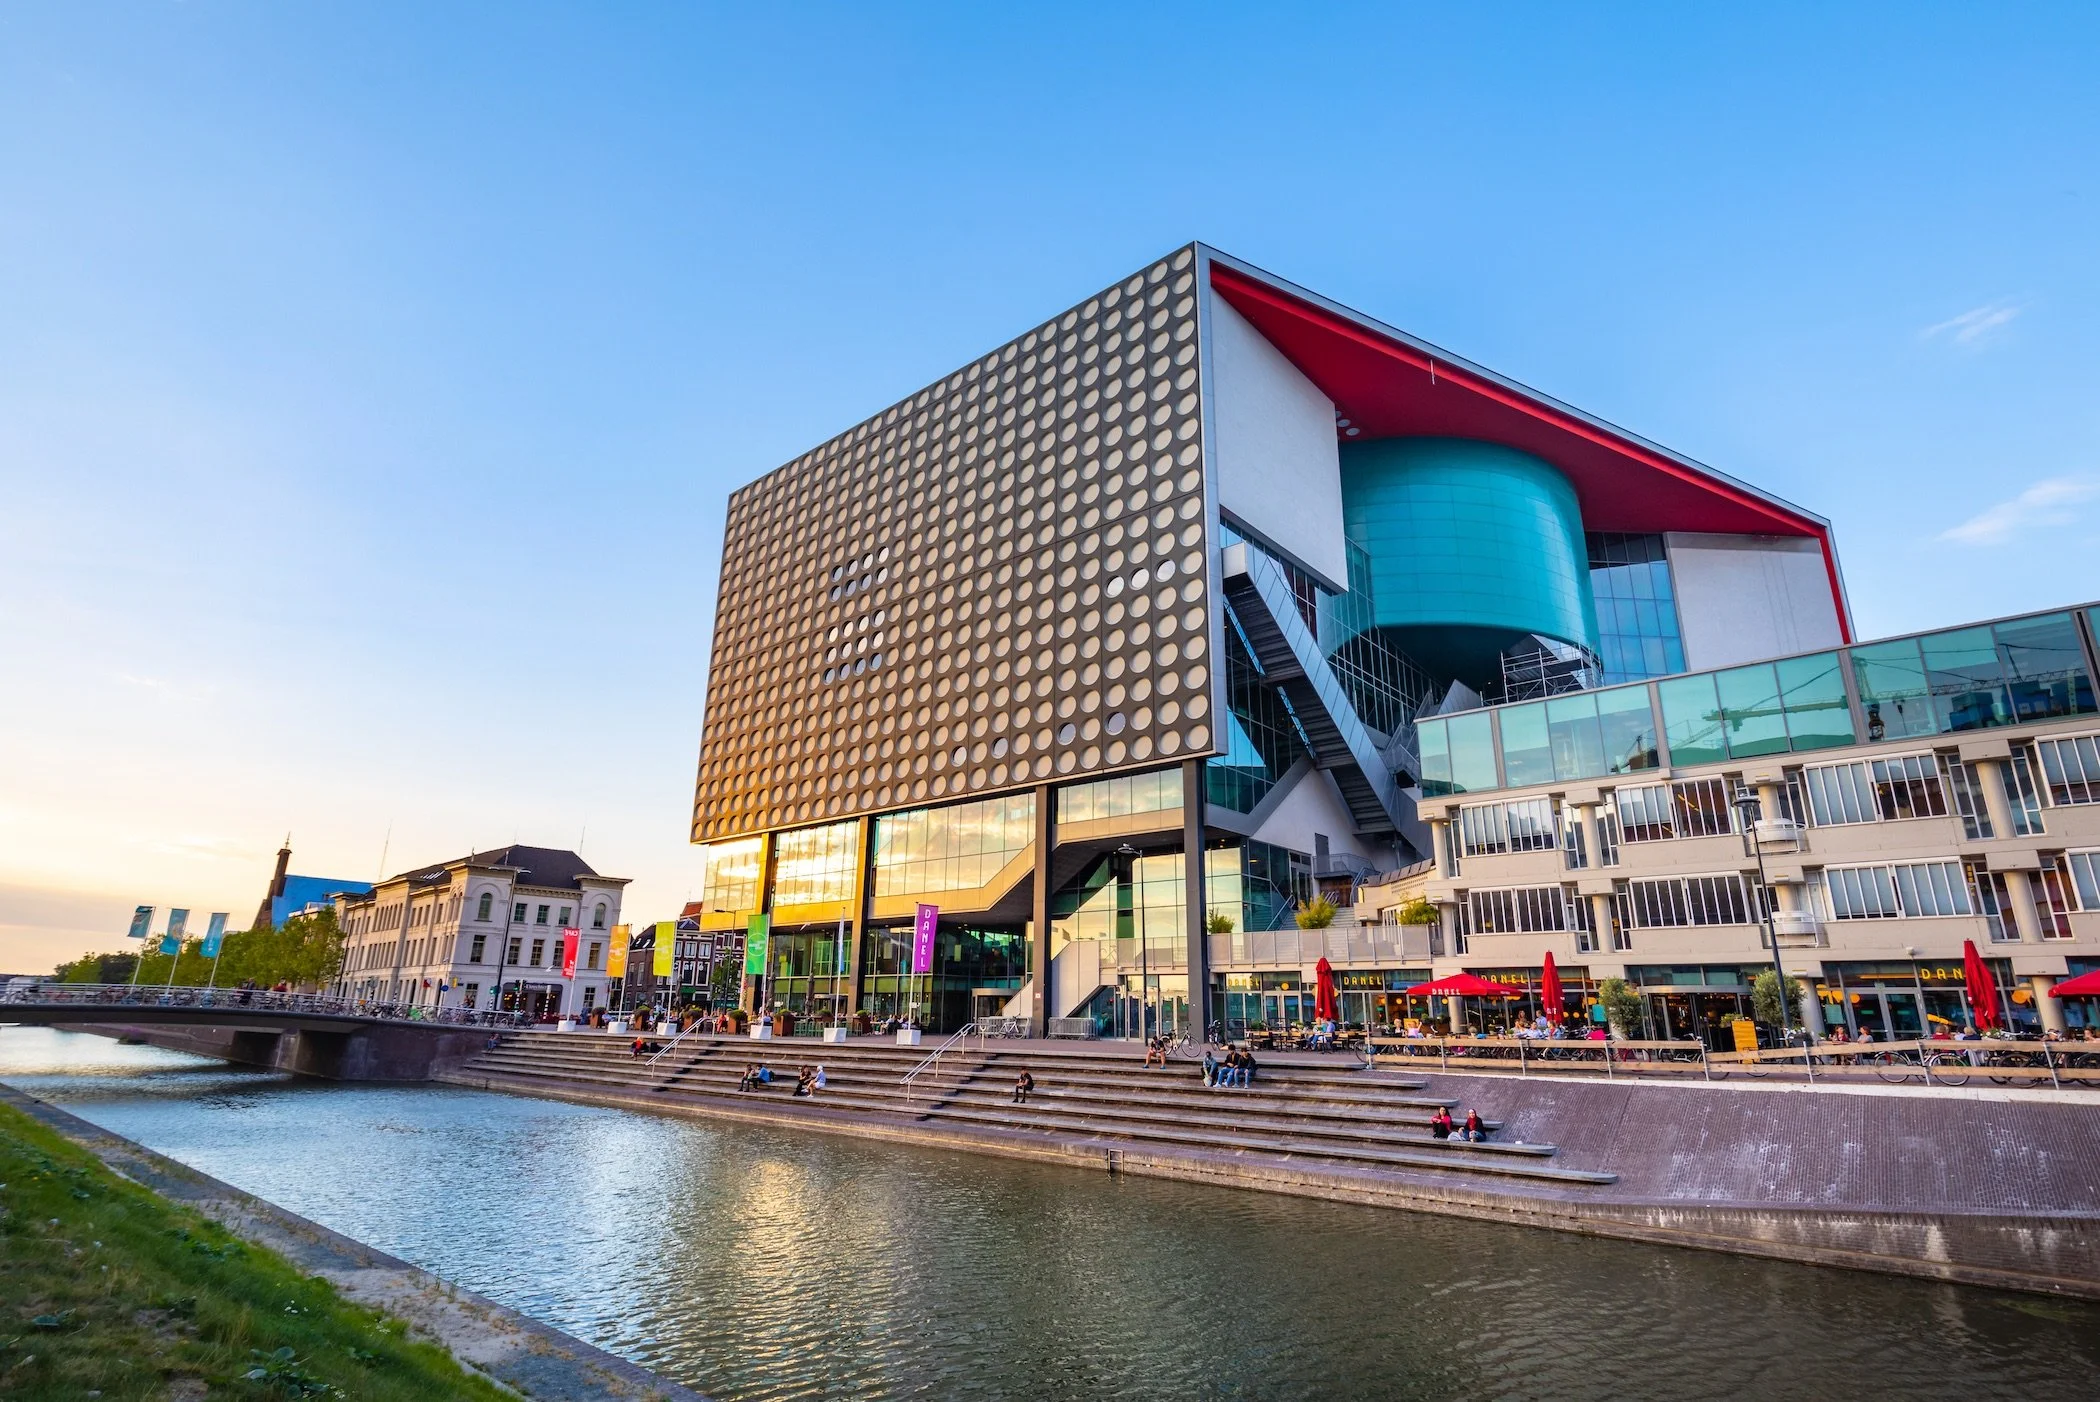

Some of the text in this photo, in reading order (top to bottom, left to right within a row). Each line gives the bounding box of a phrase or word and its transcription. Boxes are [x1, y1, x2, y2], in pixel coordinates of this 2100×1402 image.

[921, 909, 931, 967] DANEL
[1921, 968, 1964, 980] DAN
[1343, 976, 1382, 985] DANEL
